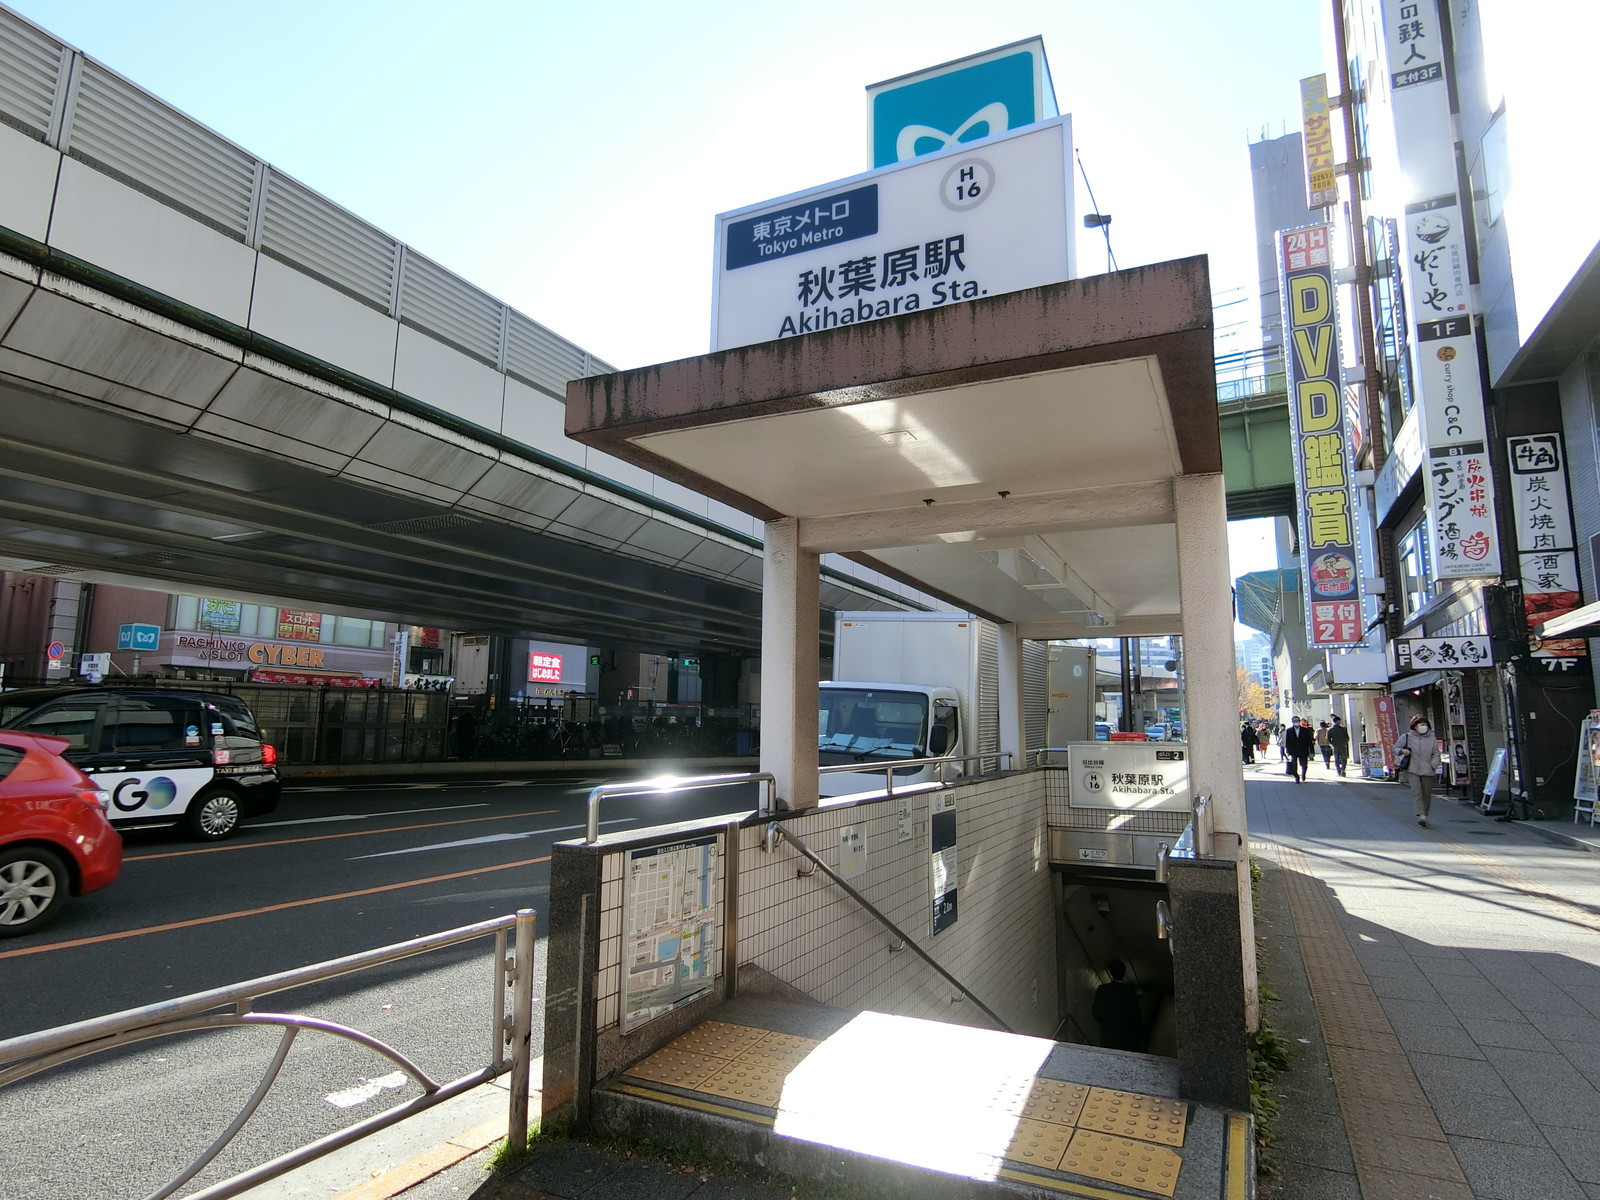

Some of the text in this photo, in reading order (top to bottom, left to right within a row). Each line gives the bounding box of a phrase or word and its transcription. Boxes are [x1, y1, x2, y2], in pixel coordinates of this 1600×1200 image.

[1397, 0, 1426, 66] の鉄人
[1395, 66, 1438, 87] 受付3F
[959, 166, 975, 182] H
[956, 183, 982, 201] 16
[1424, 200, 1438, 209] 1F
[752, 199, 850, 243] 東京メトロ
[758, 223, 844, 257] Tokyo Metro
[1287, 229, 1325, 252] 24H
[1289, 247, 1328, 269] 営業
[798, 234, 967, 308] 秋葉原駅
[777, 280, 988, 339] Akihabara Sta.
[1432, 322, 1457, 338] 1F
[1446, 385, 1454, 402] shop
[1290, 274, 1352, 549] DVD鑑賞
[1444, 405, 1463, 436] C&C
[1448, 447, 1464, 456] B1
[1518, 445, 1554, 467] 牛角
[1466, 459, 1489, 518] 炭火串焼
[1432, 461, 1465, 561] テング酒場
[1526, 476, 1556, 549] 炭火焼肉
[1534, 554, 1562, 589] 酒家
[285, 614, 315, 625] スロット
[1315, 604, 1356, 622] 受付
[278, 622, 321, 641] 専門店
[1319, 623, 1356, 641] 2F
[178, 636, 247, 651] PACHINKO
[199, 650, 245, 662] & SLOT
[248, 643, 325, 668] CYBER
[533, 655, 561, 668] 朝定食
[532, 668, 561, 680] はじめました
[1541, 658, 1578, 672] 7F
[1173, 751, 1180, 760] 2
[1089, 781, 1100, 789] 16
[1111, 773, 1164, 786] 秋葉原駅
[1112, 785, 1178, 795] Akihabara Sta.
